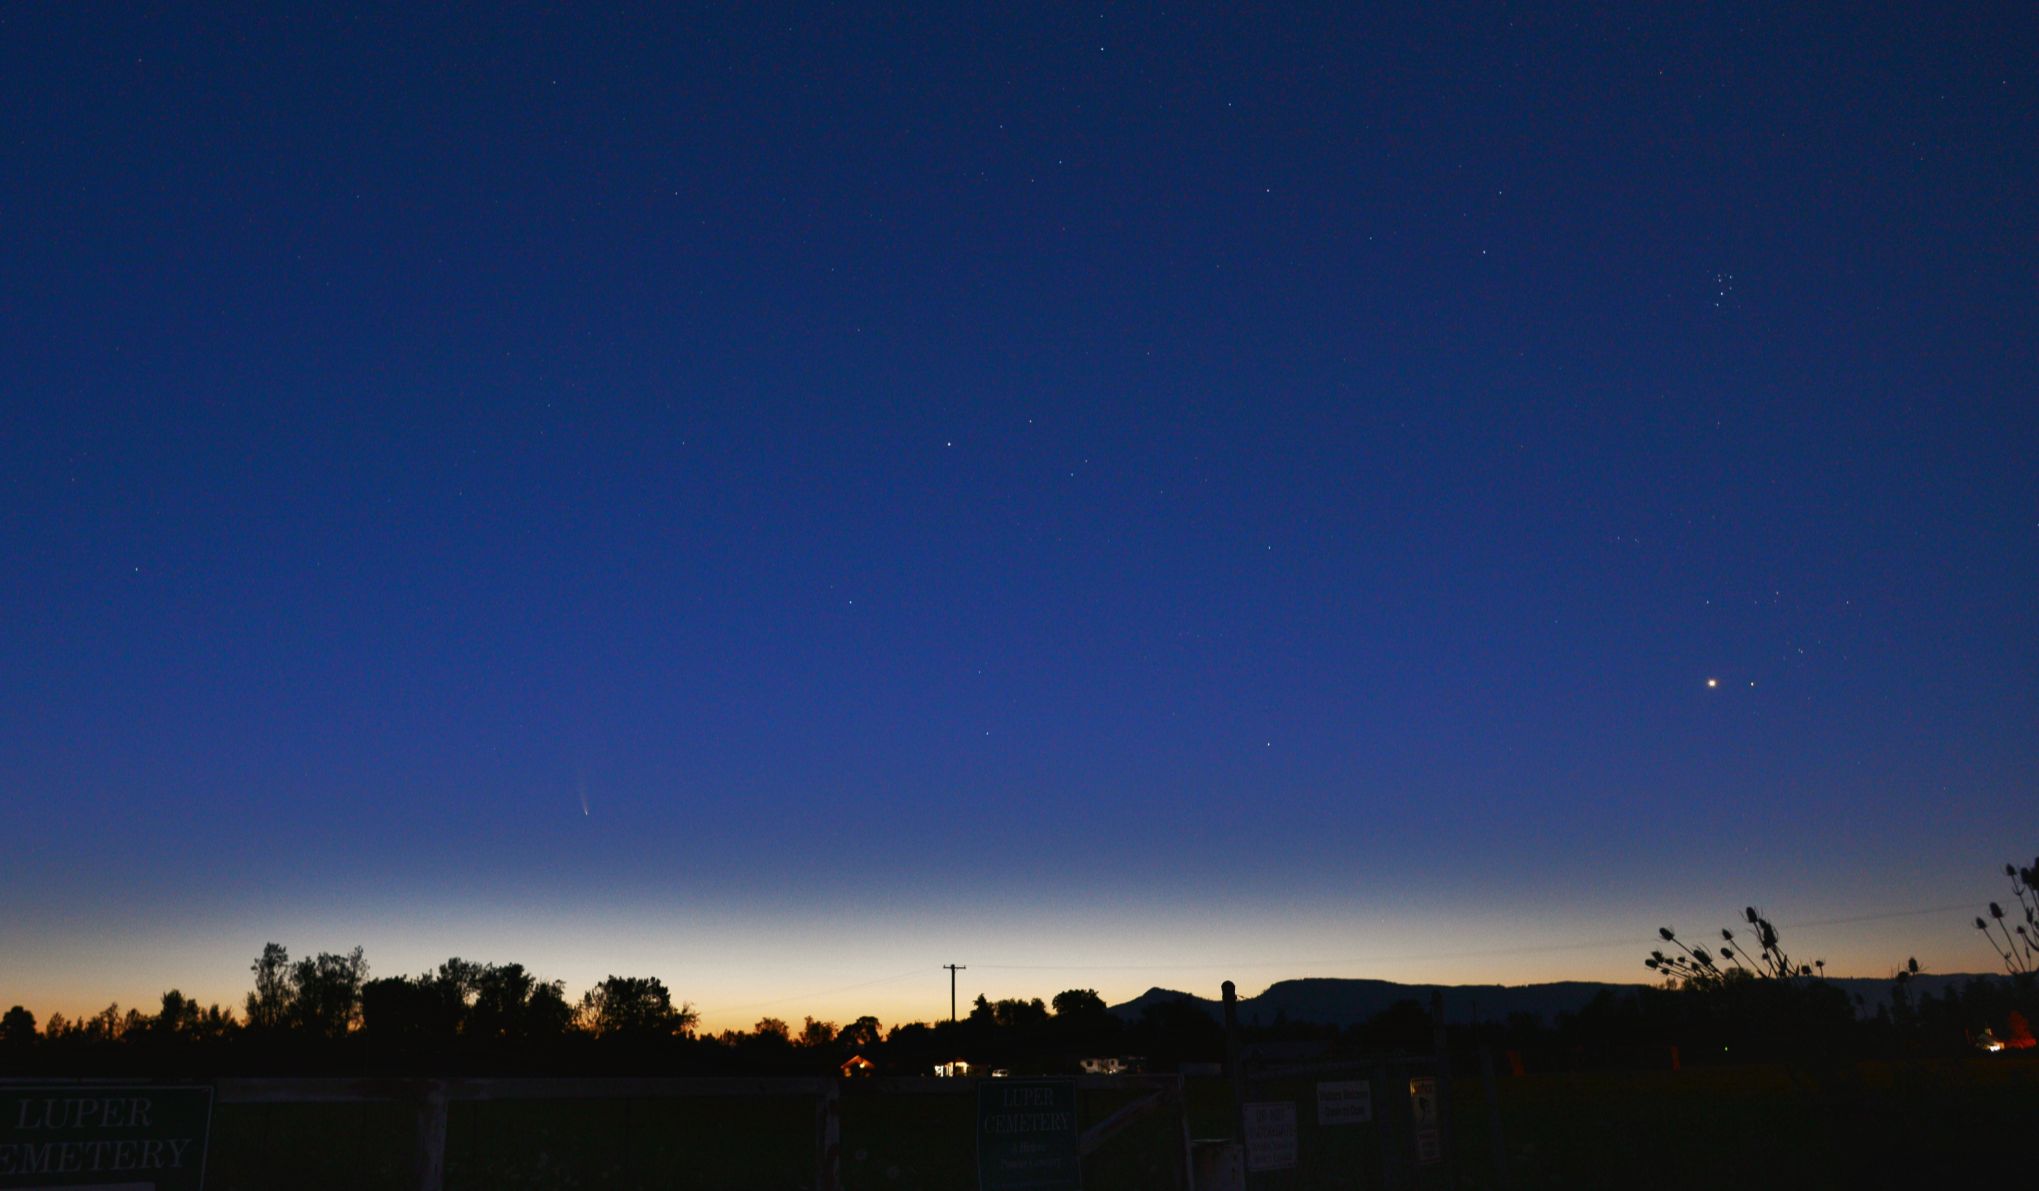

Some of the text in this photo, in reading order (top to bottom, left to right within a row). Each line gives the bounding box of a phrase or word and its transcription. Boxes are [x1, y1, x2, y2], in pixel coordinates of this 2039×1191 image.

[1003, 1088, 1053, 1106] LUPER
[15, 1098, 152, 1129] LUPER
[984, 1112, 1069, 1133] CEMETERY
[0, 1139, 191, 1174] EMETERY
